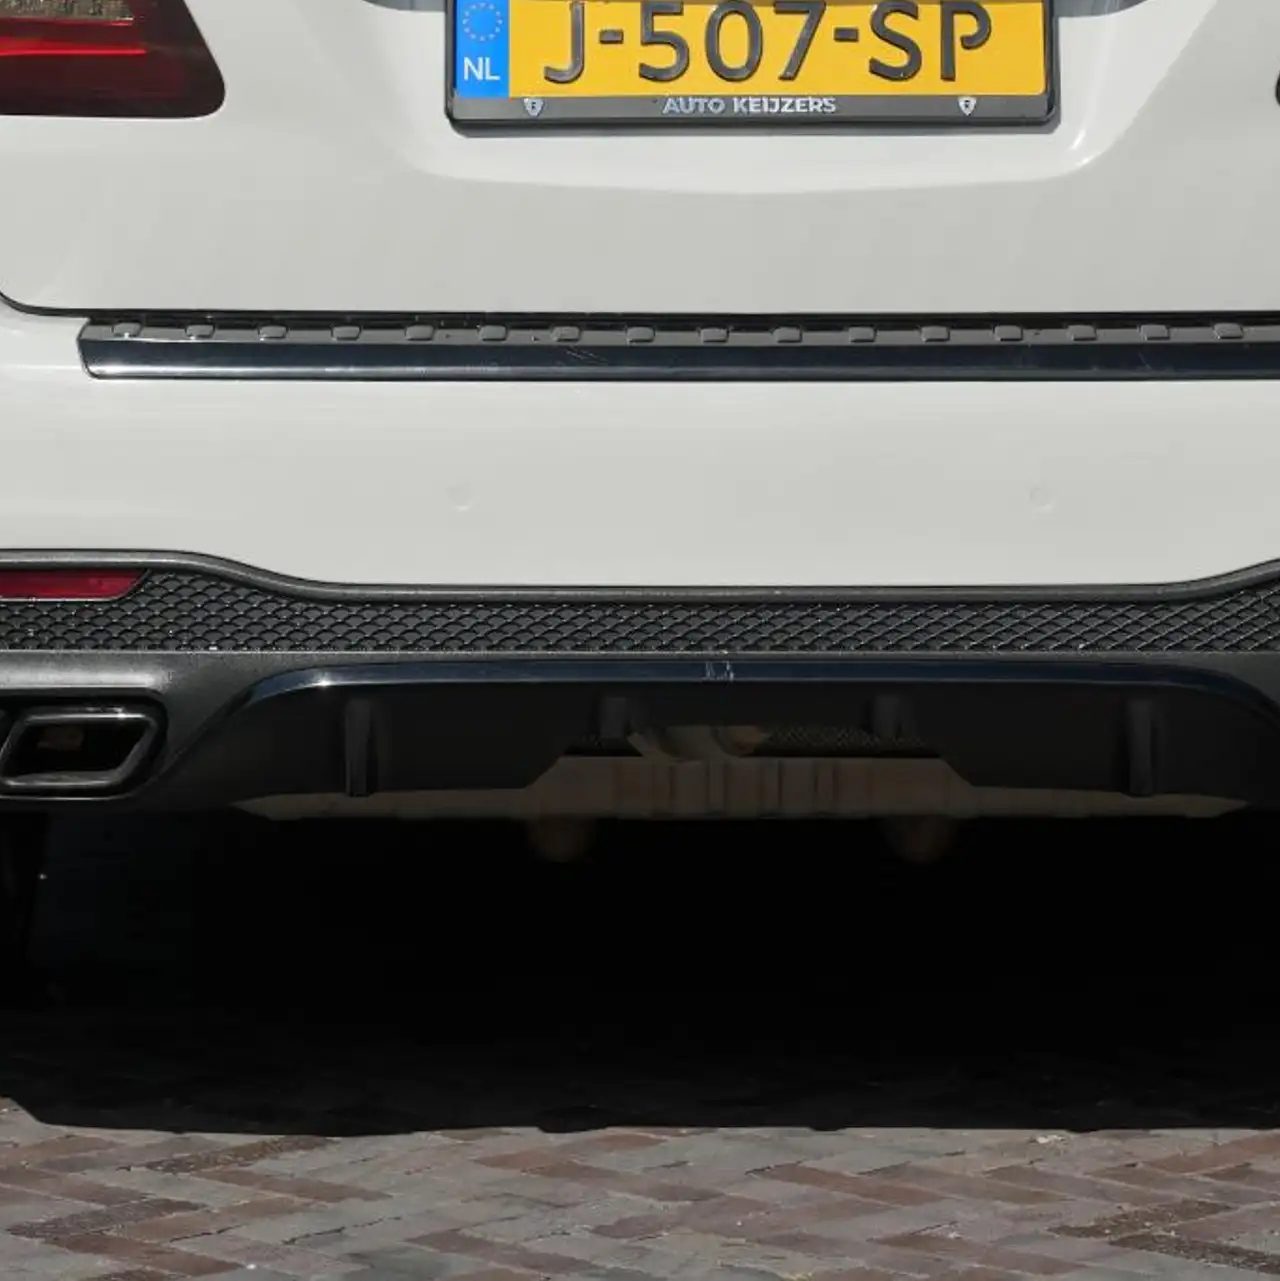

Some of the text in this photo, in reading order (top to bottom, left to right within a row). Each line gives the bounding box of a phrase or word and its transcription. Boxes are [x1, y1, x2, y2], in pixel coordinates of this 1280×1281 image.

[463, 56, 500, 81] NL
[662, 96, 837, 114] AUTO KEIJZERS
